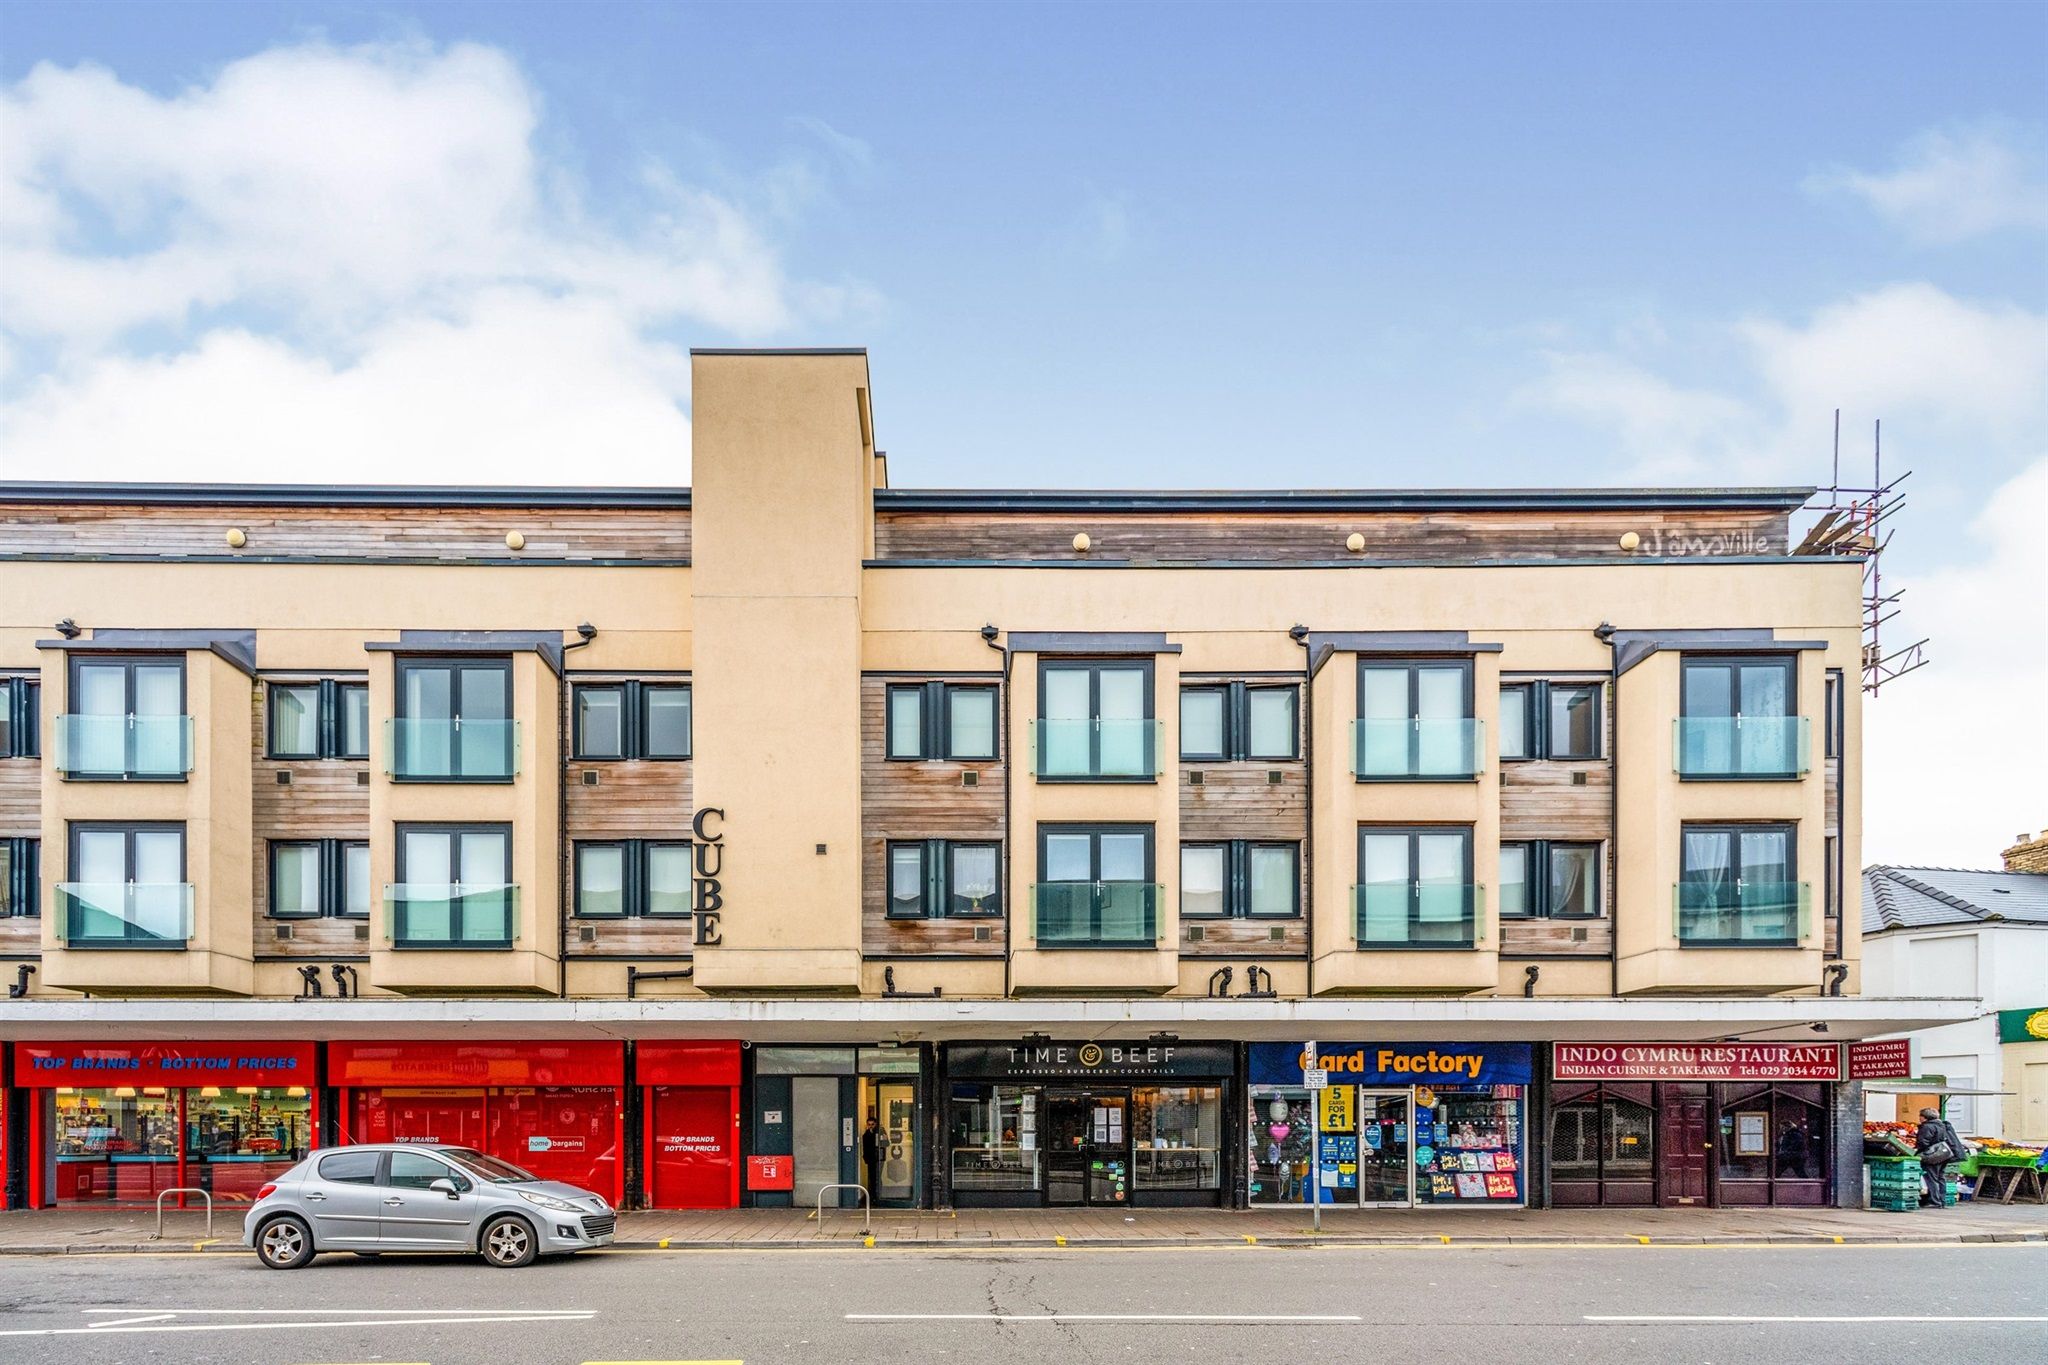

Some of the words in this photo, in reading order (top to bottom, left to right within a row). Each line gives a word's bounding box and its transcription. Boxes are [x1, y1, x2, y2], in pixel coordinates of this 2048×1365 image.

[692, 807, 725, 946] CUBE
[1875, 1043, 1905, 1051] CYMRU
[1007, 1047, 1068, 1063] TIME
[1111, 1047, 1175, 1063] BEEF
[1561, 1047, 1617, 1062] INDO
[1621, 1047, 1696, 1062] CYMRU
[1699, 1047, 1835, 1063] RESTAURANT
[1853, 1052, 1906, 1061] RESTAURANT
[32, 1057, 66, 1070] TOP
[71, 1057, 140, 1070] BRANDS
[161, 1057, 232, 1070] BOTTOM
[237, 1057, 298, 1070] PRICES
[1377, 1050, 1484, 1078] Factory
[1860, 1061, 1906, 1070] TAKEAWAY
[1561, 1065, 1605, 1075] INDIAN
[1607, 1065, 1657, 1075] CUISINE
[1658, 1065, 1668, 1075] &
[1670, 1065, 1732, 1075] TAKEAWAY
[1739, 1065, 1759, 1076] Tel:
[1760, 1066, 1780, 1076] 029
[1780, 1066, 1808, 1076] 2034
[1809, 1065, 1836, 1076] 4770
[1332, 1087, 1342, 1100] 5
[1328, 1105, 1345, 1113] FOR
[1328, 1113, 1346, 1128] £1
[394, 1136, 410, 1144] TOP
[410, 1136, 440, 1144] BRANDS
[529, 1139, 549, 1147] home
[552, 1139, 583, 1149] bargains
